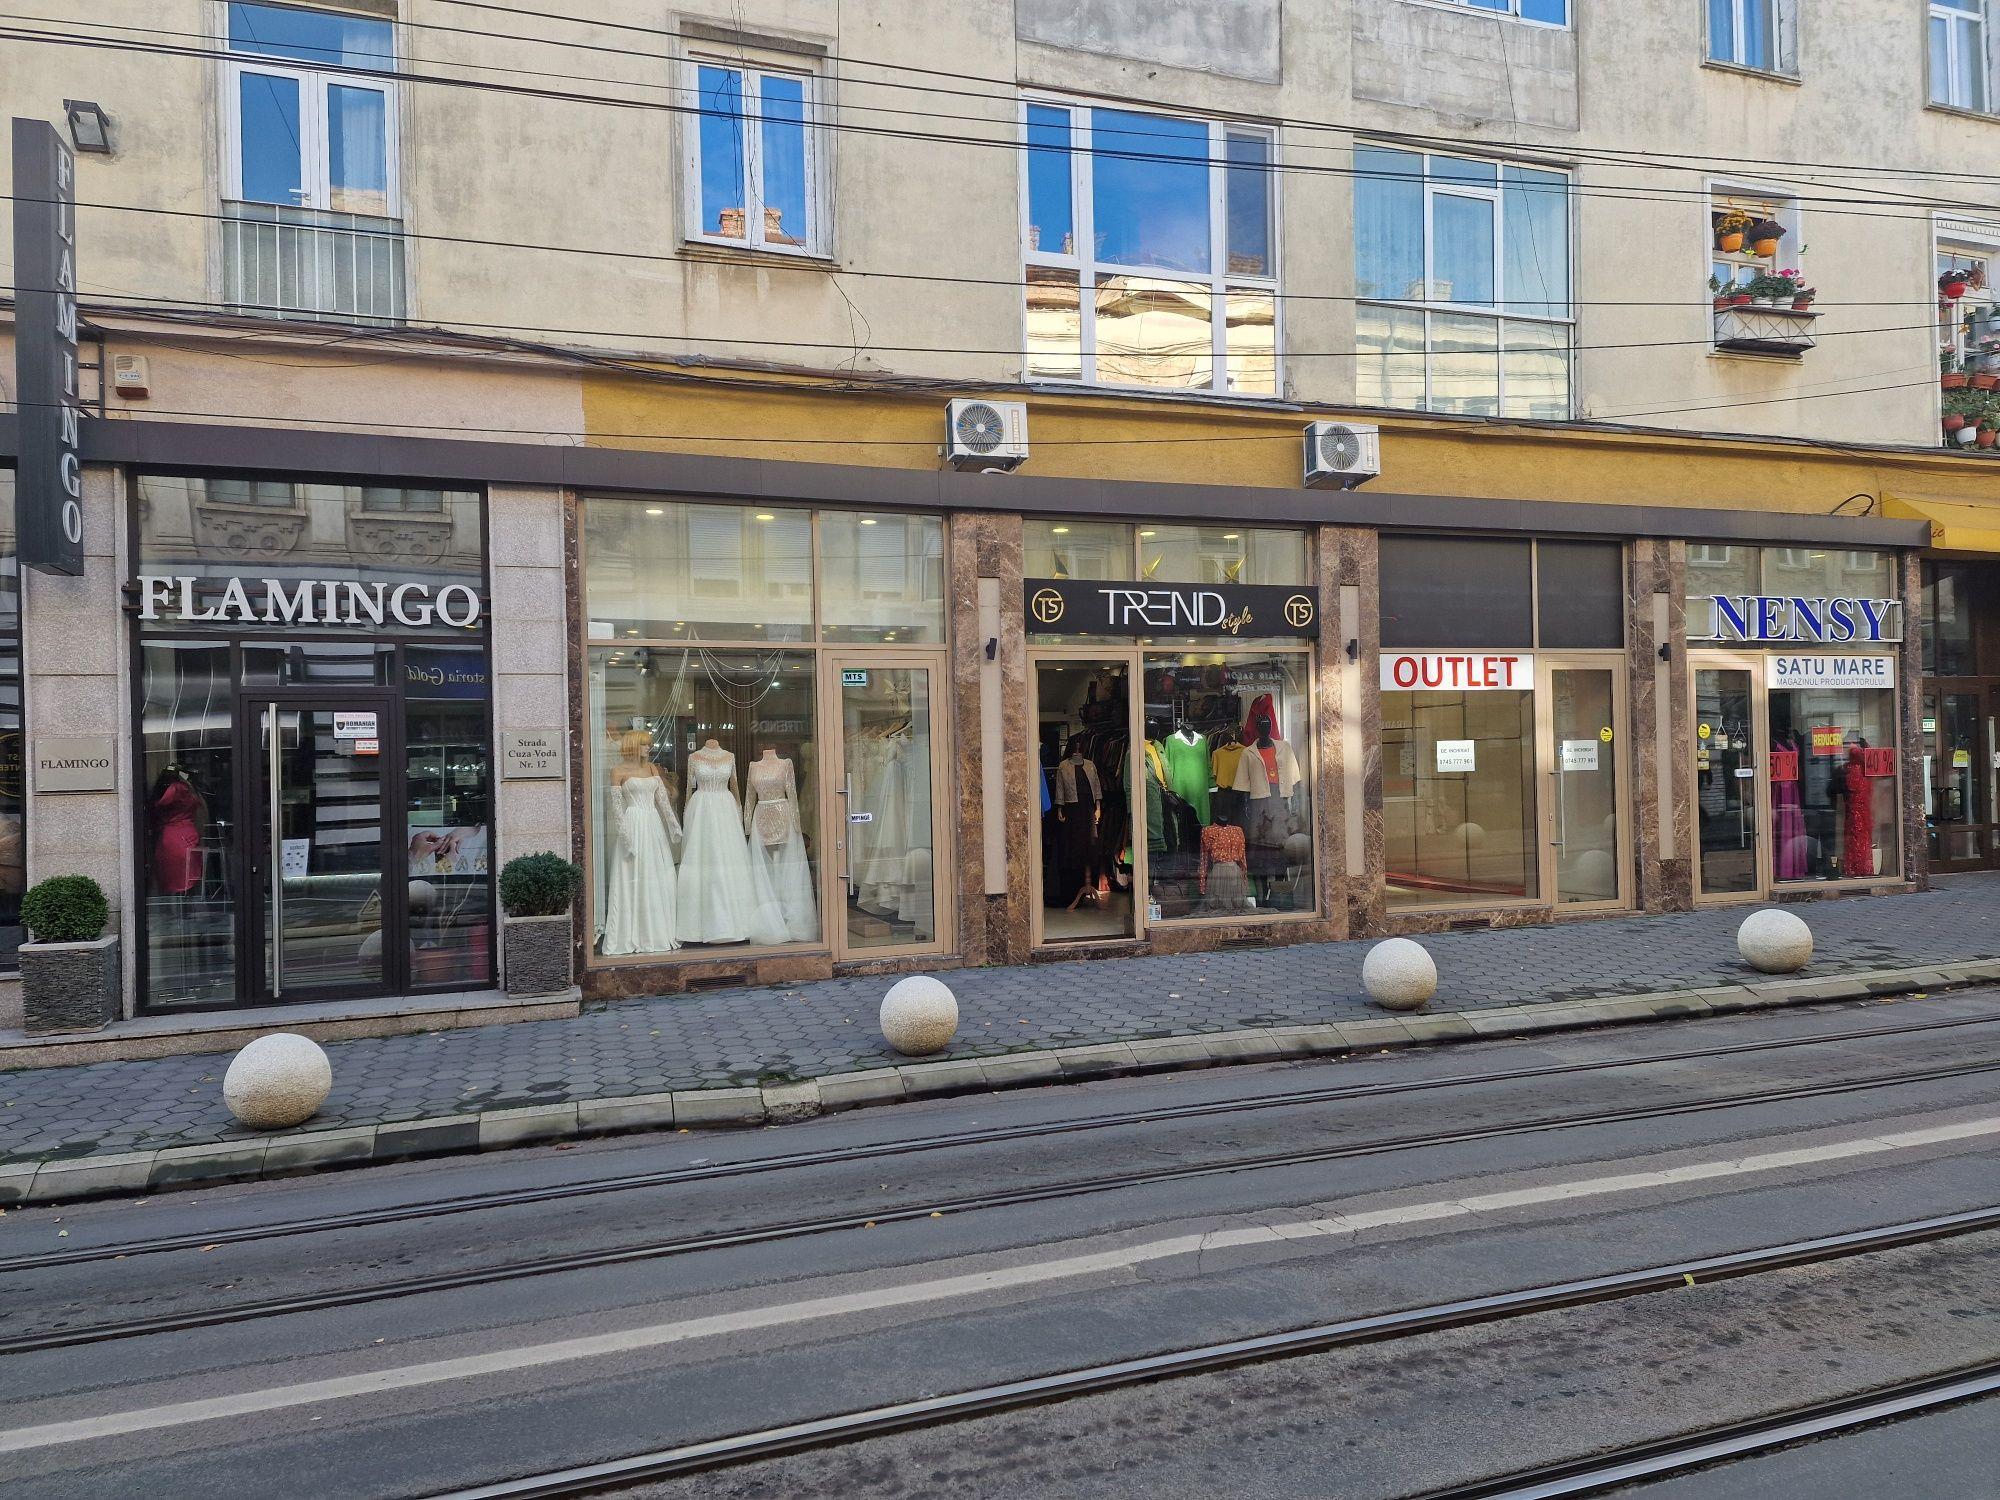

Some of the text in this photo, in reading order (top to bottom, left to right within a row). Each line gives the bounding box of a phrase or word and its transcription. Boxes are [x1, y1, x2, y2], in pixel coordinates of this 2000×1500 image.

[56, 143, 82, 544] FLAMINGO
[137, 575, 481, 627] FLAMINGO
[1036, 596, 1064, 622] TS
[1098, 589, 1254, 635] TREND style
[1288, 602, 1313, 627] TS
[1710, 595, 1893, 643] NENSY
[1393, 656, 1519, 688] OUTLET
[1776, 657, 1885, 676] SATU MARE
[1776, 677, 1819, 686] MAGAZINUL
[518, 739, 547, 747] Strada
[40, 758, 109, 769] FLAMINGO
[519, 760, 547, 769] Nr. 12
[1769, 753, 1797, 778] 50 %
[1866, 750, 1894, 774] 40 %
